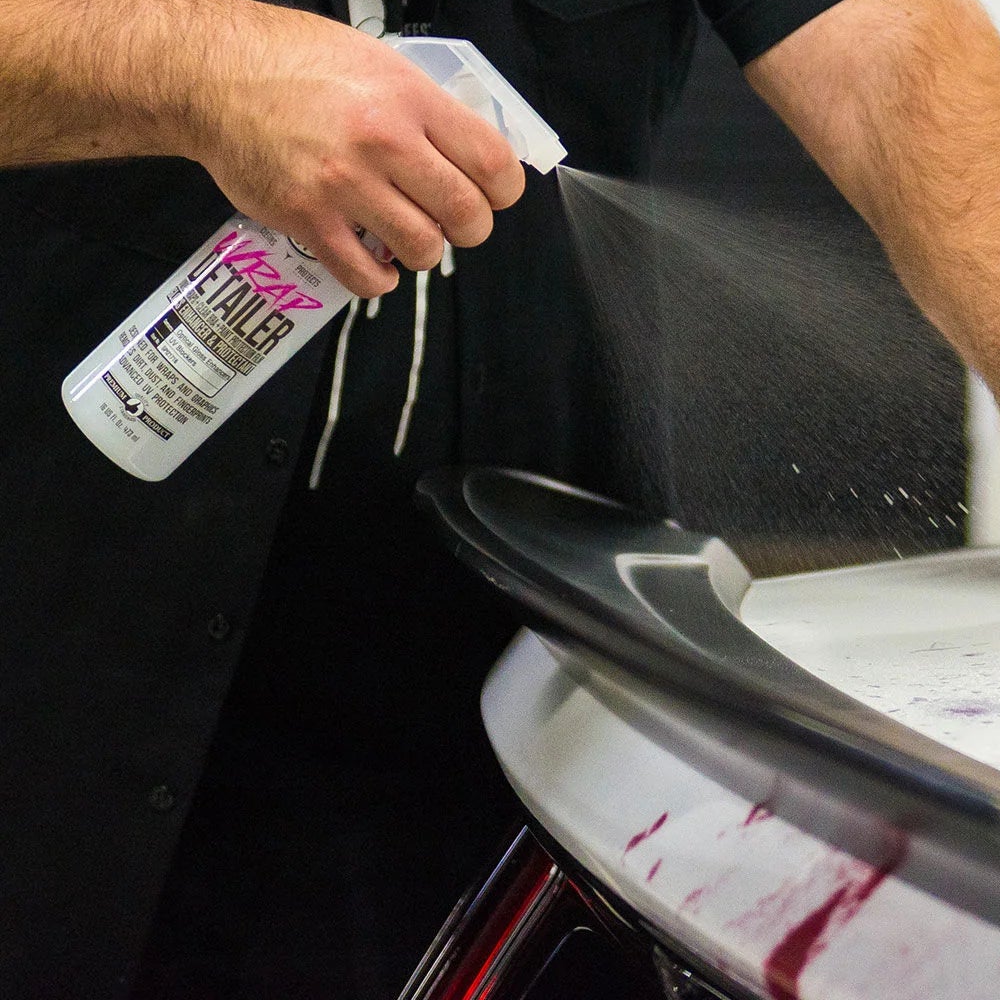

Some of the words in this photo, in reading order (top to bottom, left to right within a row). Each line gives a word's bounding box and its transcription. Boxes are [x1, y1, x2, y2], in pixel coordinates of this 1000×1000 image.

[212, 231, 323, 311] WRAP
[295, 264, 321, 287] PROTECTS
[188, 250, 295, 356] DETAILER
[168, 337, 177, 346] UV
[175, 344, 196, 366] Blockers
[176, 329, 194, 347] Optical
[191, 345, 207, 361] Gloss
[205, 358, 231, 380] Enhancers
[178, 302, 212, 340] ENHANCER
[213, 340, 255, 376] PROTECTANT
[103, 372, 127, 400] PREMIUM
[144, 348, 158, 363] FOR
[156, 361, 179, 385] WRAPS
[177, 383, 193, 396] AND
[190, 393, 219, 414] GRAPHICS
[141, 383, 152, 395] UV
[151, 393, 188, 425] PROTECTION
[159, 385, 176, 399] AND
[173, 396, 212, 424] FINGERPRINTS
[141, 415, 169, 438] PRODUCT
